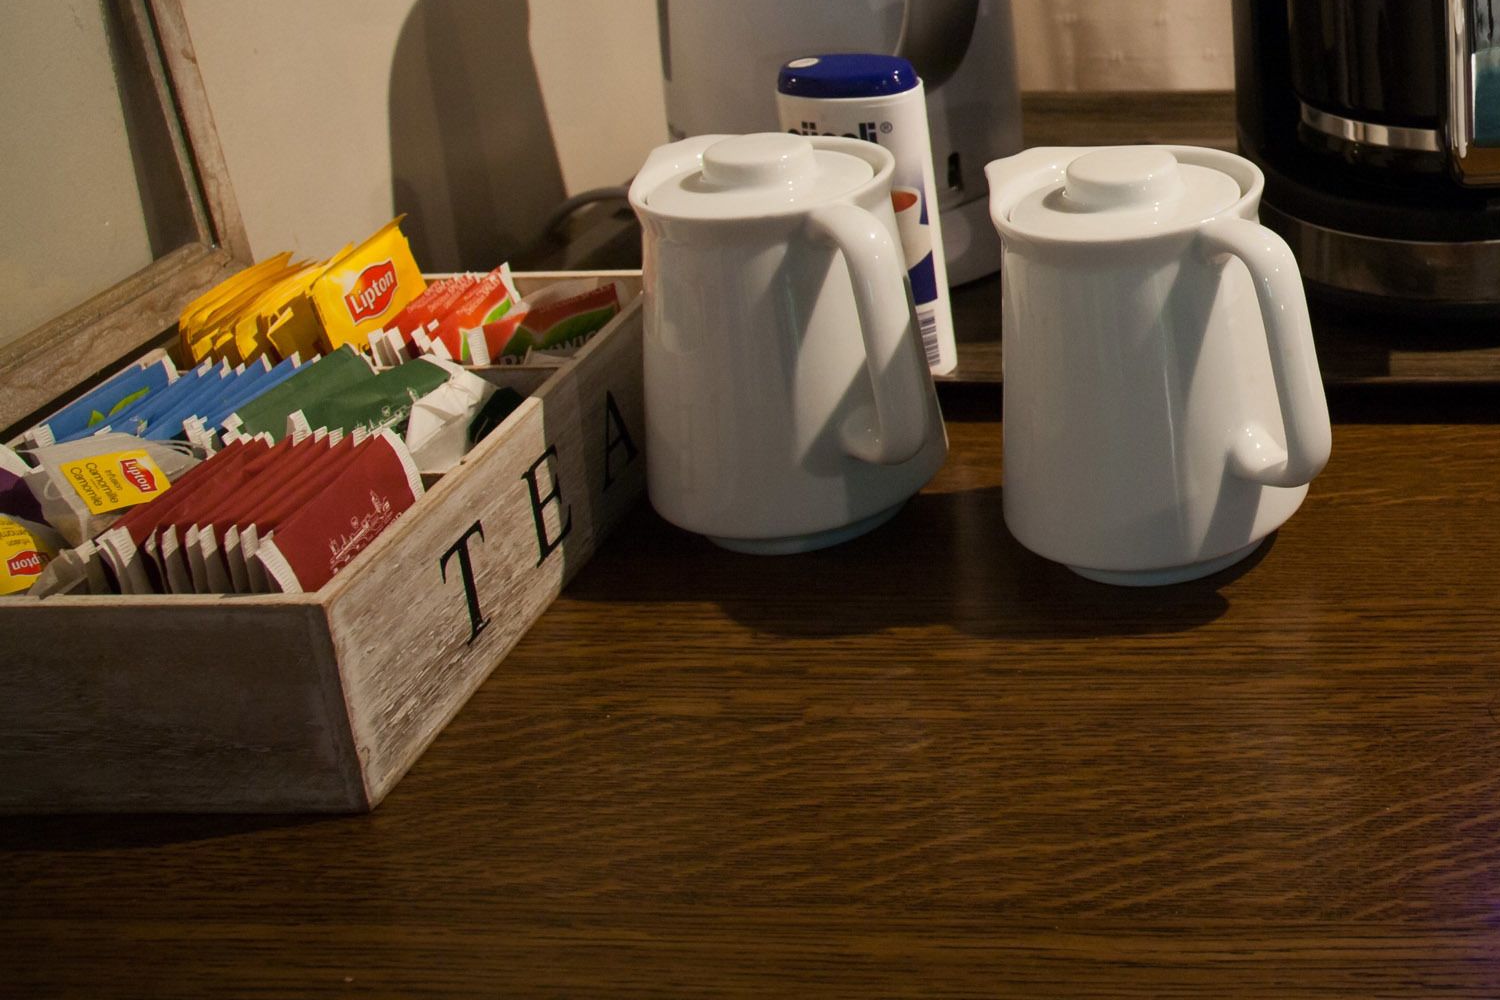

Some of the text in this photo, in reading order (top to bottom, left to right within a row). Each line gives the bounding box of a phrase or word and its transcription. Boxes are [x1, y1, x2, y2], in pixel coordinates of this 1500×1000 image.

[350, 271, 394, 314] Lipton
[125, 460, 152, 491] Lipton
[439, 390, 637, 646] TEA
[11, 553, 42, 570] pton
